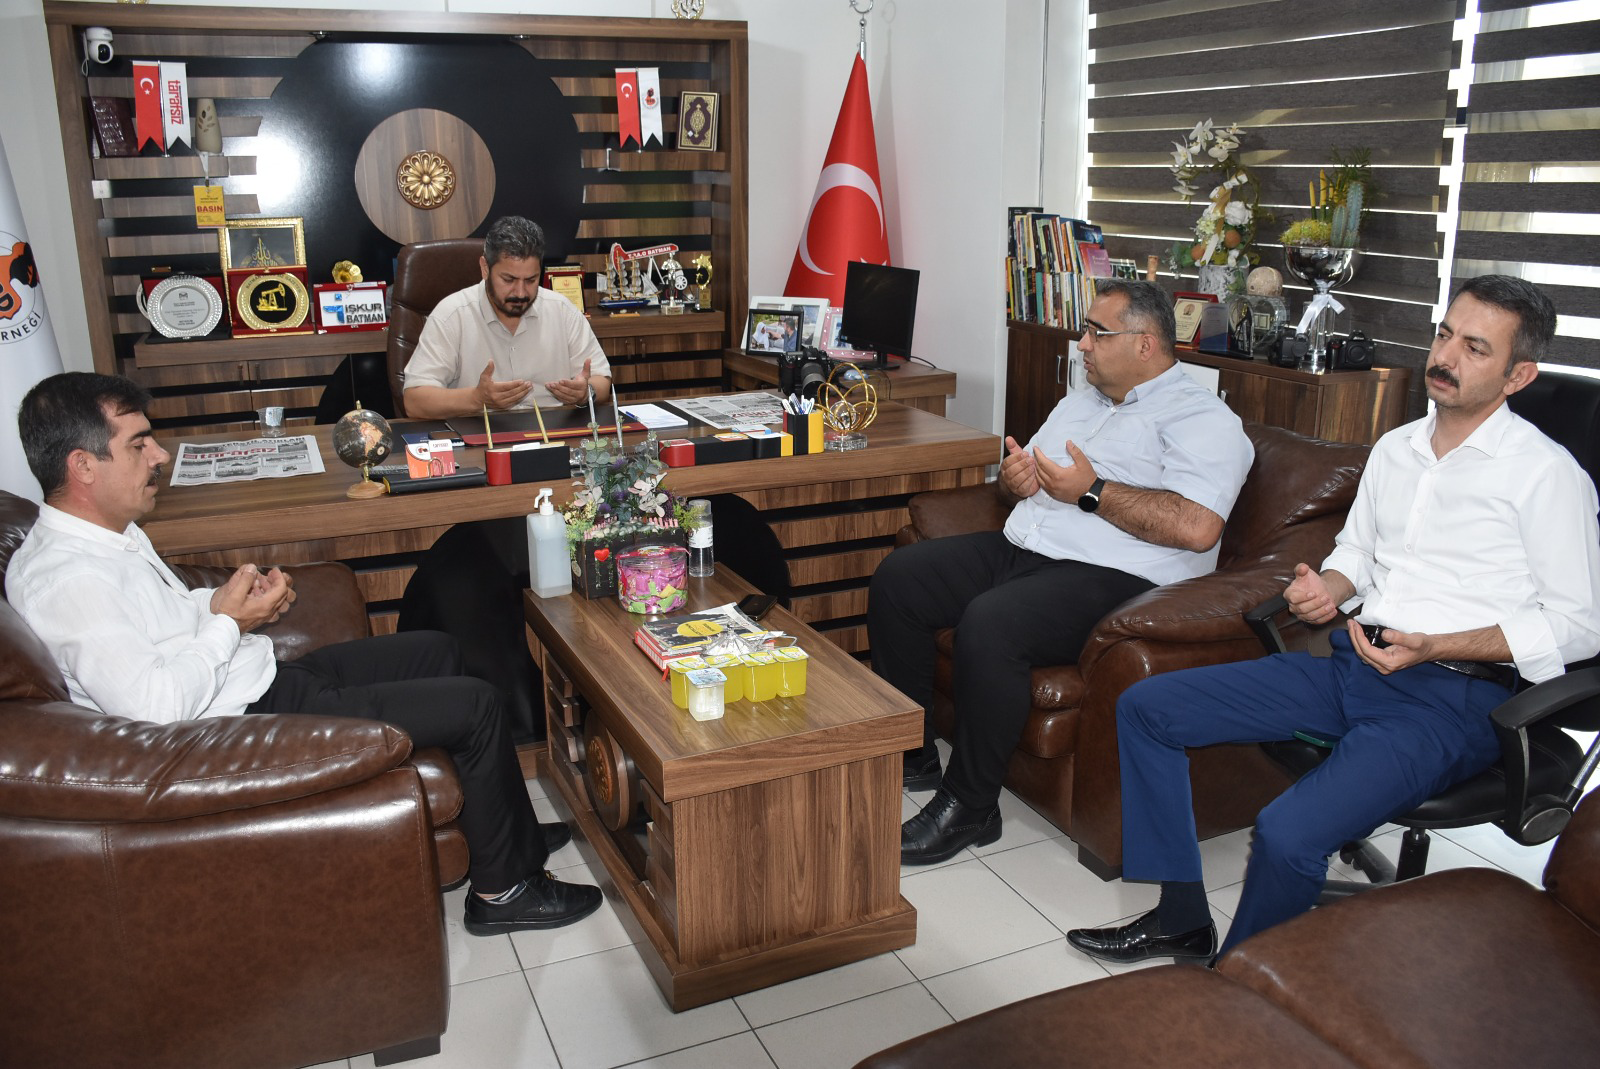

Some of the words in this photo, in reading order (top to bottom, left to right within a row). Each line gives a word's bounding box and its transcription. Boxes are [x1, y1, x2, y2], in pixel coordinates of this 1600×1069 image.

[167, 79, 183, 125] tarafsız
[196, 205, 224, 213] BASIN
[647, 246, 671, 255] BATMAN
[346, 313, 384, 324] BATMAN
